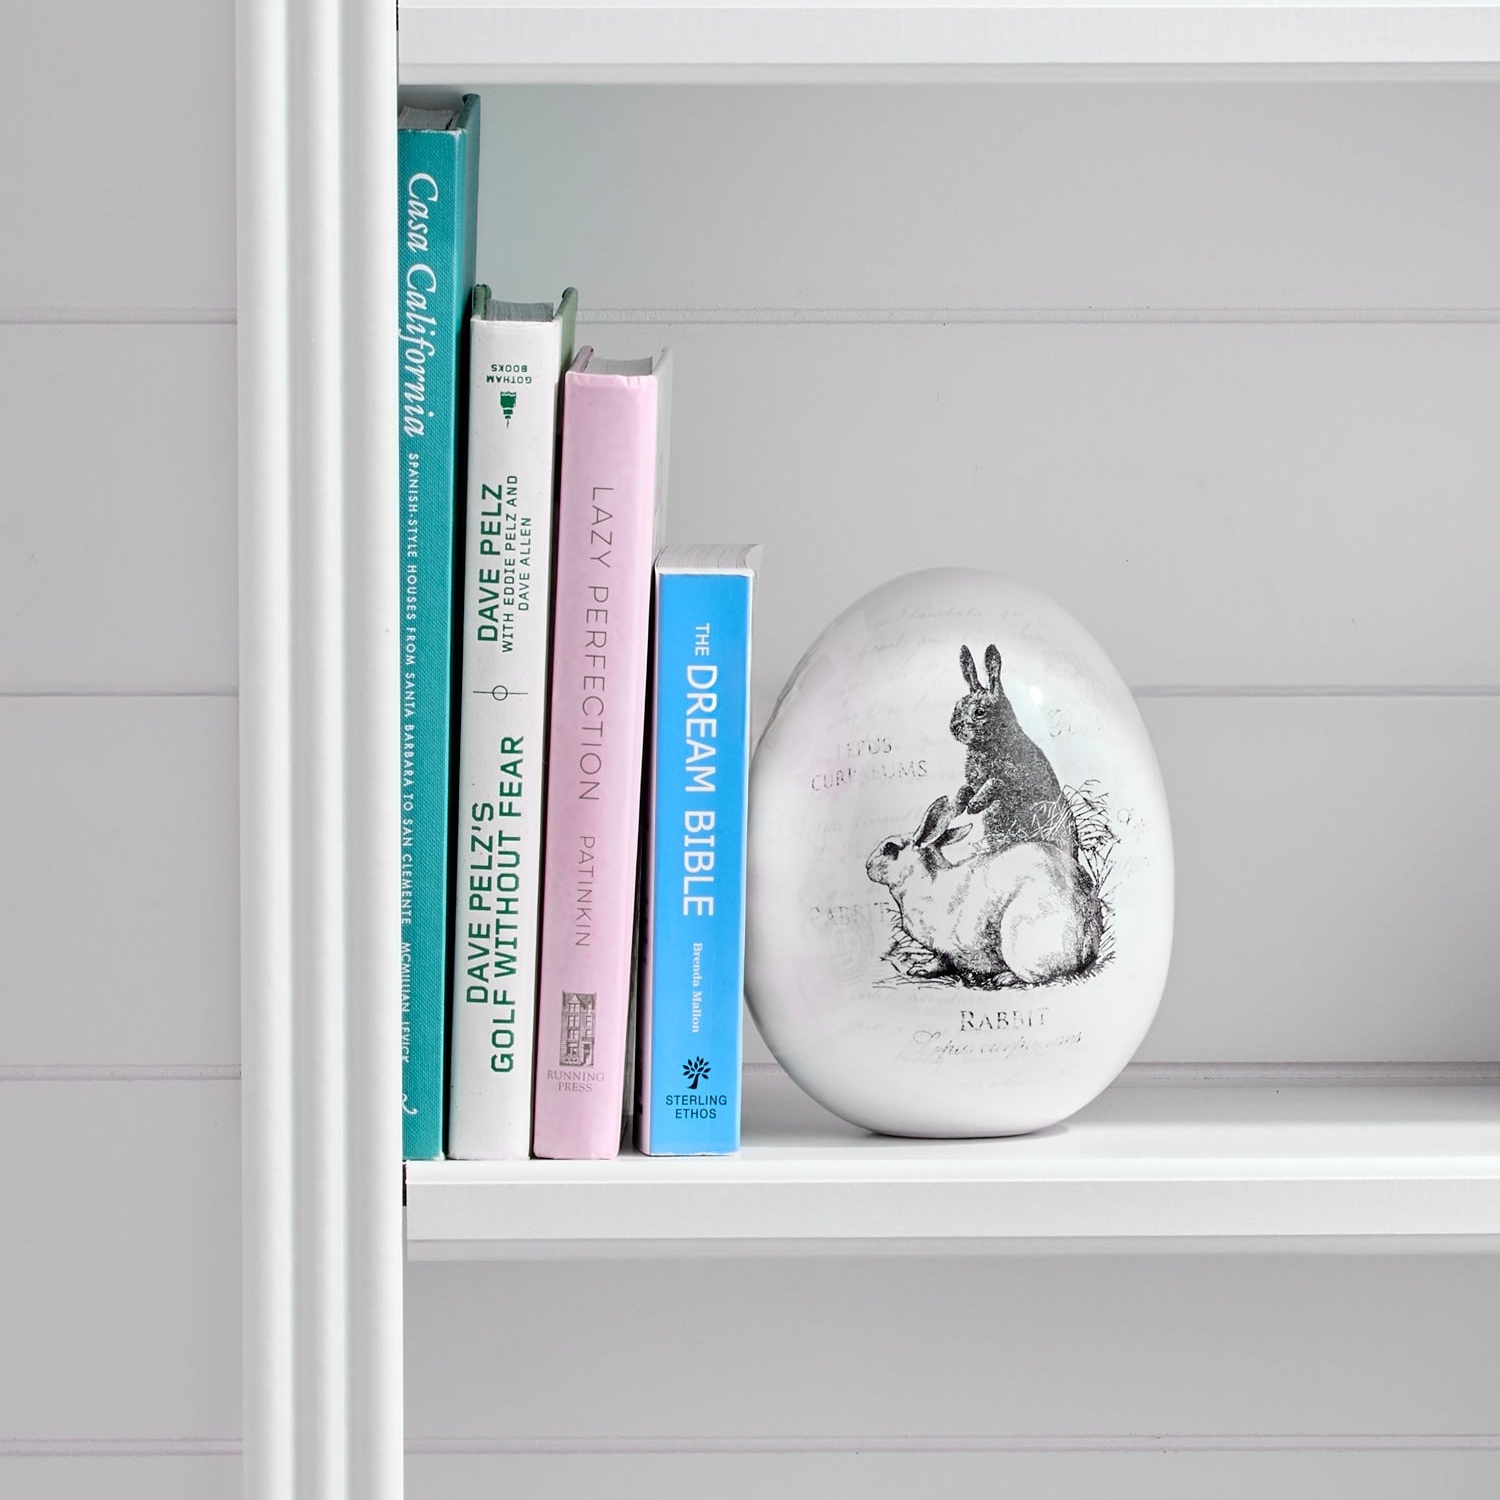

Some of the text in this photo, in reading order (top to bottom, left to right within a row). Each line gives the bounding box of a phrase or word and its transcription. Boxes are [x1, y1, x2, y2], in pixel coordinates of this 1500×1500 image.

[399, 172, 438, 438] Casa California
[486, 375, 533, 385] GOTHAM
[490, 363, 529, 373] BOOKS
[407, 453, 419, 558] SPANISH-STYLE
[406, 564, 418, 621] HOUSES
[477, 483, 502, 642] DAVE PELZ
[502, 475, 519, 653] WITH EDDIE PELZ AND
[518, 516, 532, 611] DAVE ALLEN
[405, 627, 417, 666] FROM
[404, 672, 416, 718] SANTA
[575, 486, 614, 947] LAZY PERFECTION PATINKIN
[403, 725, 415, 788] BARBARA
[682, 623, 718, 917] THE DREAM BIBLE
[403, 794, 414, 812] TO
[402, 819, 413, 848] SAN
[400, 853, 412, 925] CLEMENTE
[466, 802, 494, 1004] DAVE PELZ'S
[490, 736, 524, 1073] GOLF WITHOUT FEAR
[691, 942, 703, 1034] Brenda Mallon
[959, 1007, 1050, 1033] RABBIT
[547, 1069, 605, 1083] RUNNING
[558, 1081, 593, 1093] PRESS
[665, 1095, 728, 1107] STERLING
[674, 1108, 718, 1120] ETHOS
